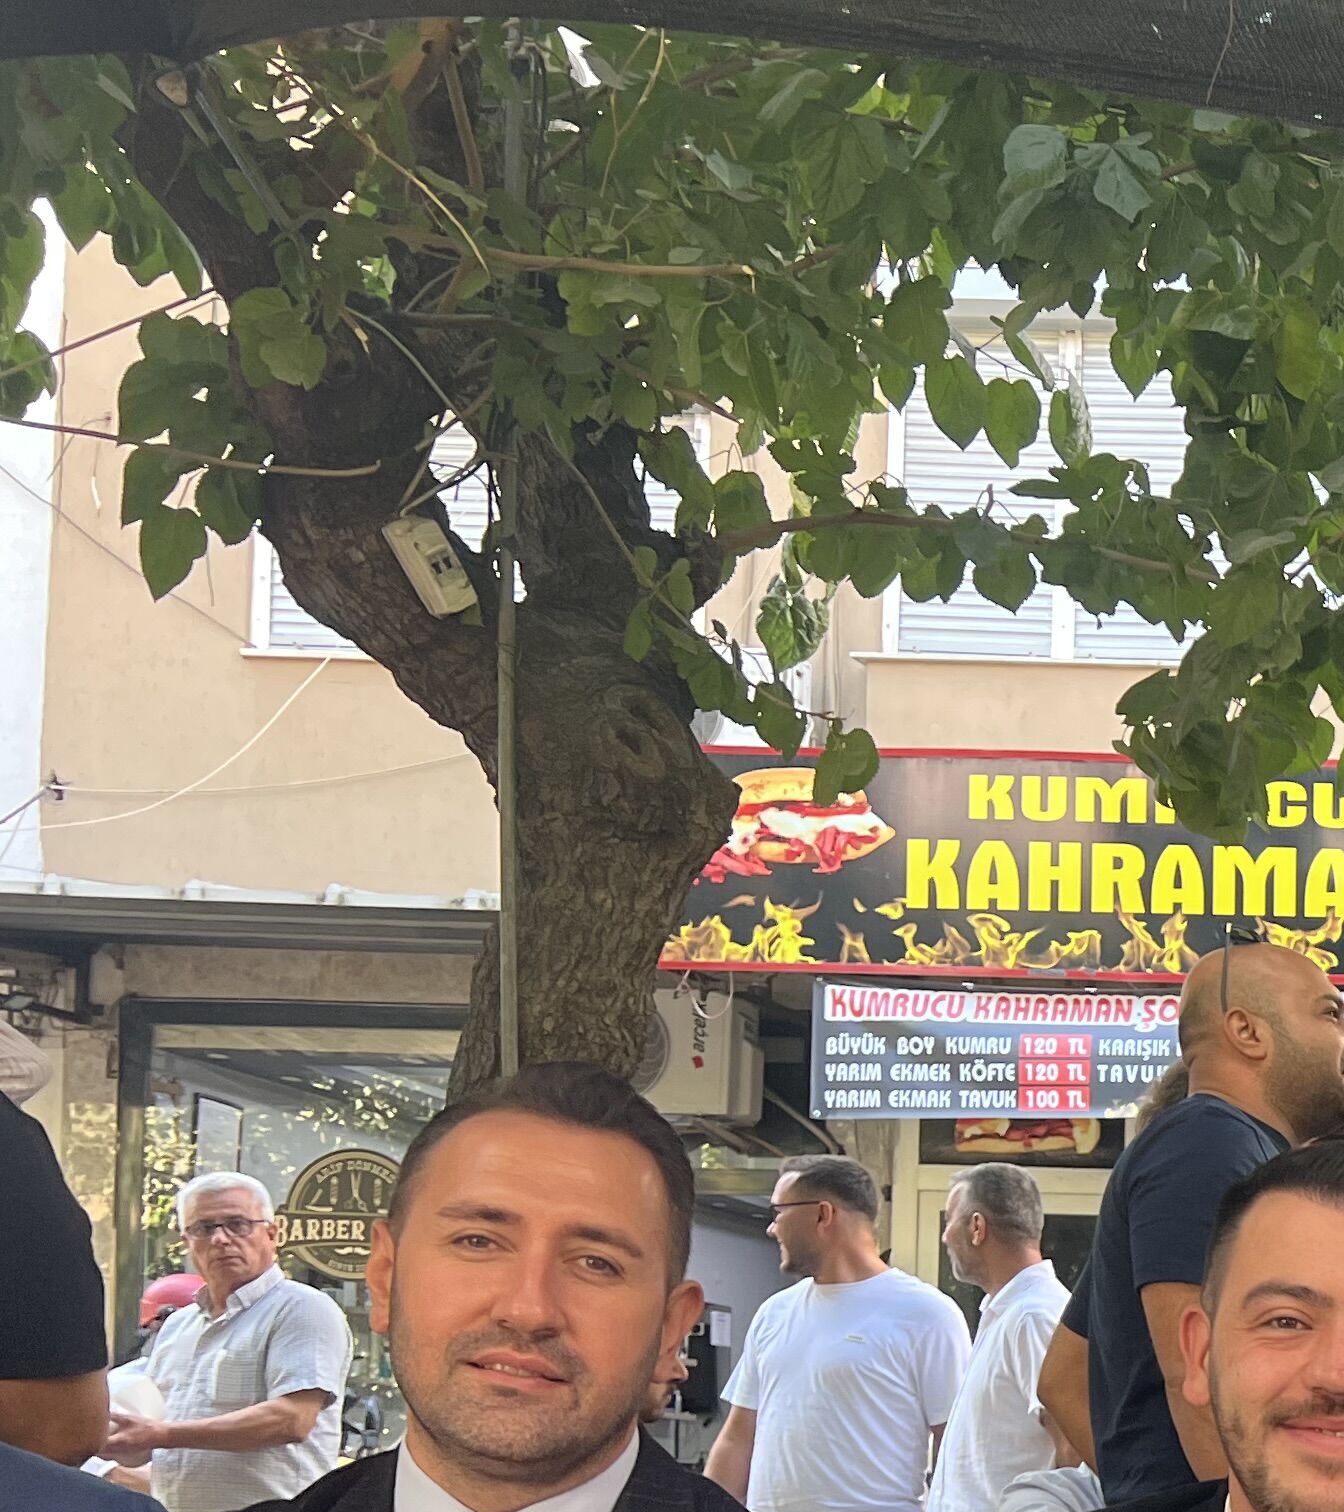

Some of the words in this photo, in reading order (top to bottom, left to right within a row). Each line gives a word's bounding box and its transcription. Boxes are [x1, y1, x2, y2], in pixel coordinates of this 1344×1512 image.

[831, 988, 966, 1018] KUMRUCU
[973, 992, 1133, 1023] KAHRAMAN
[692, 999, 709, 1053] arçelk
[825, 1033, 886, 1056] BÜYÜK
[896, 1036, 935, 1056] BOY
[945, 1036, 1012, 1056] KUMRU
[1024, 1037, 1057, 1055] 120
[1068, 1038, 1088, 1056] TL
[1098, 1039, 1171, 1062] KARIŞIK
[825, 1062, 882, 1082] YARIM
[889, 1063, 951, 1082] EKMEK
[959, 1059, 1016, 1082] KÖFTE
[1025, 1063, 1059, 1081] 120
[1067, 1064, 1087, 1082] TL
[824, 1089, 881, 1109] YARIM
[888, 1089, 951, 1109] EKMAK
[958, 1090, 1017, 1109] TAVUK
[1026, 1090, 1060, 1108] 100
[1067, 1090, 1087, 1108] TL
[274, 1214, 366, 1248] BARBER
